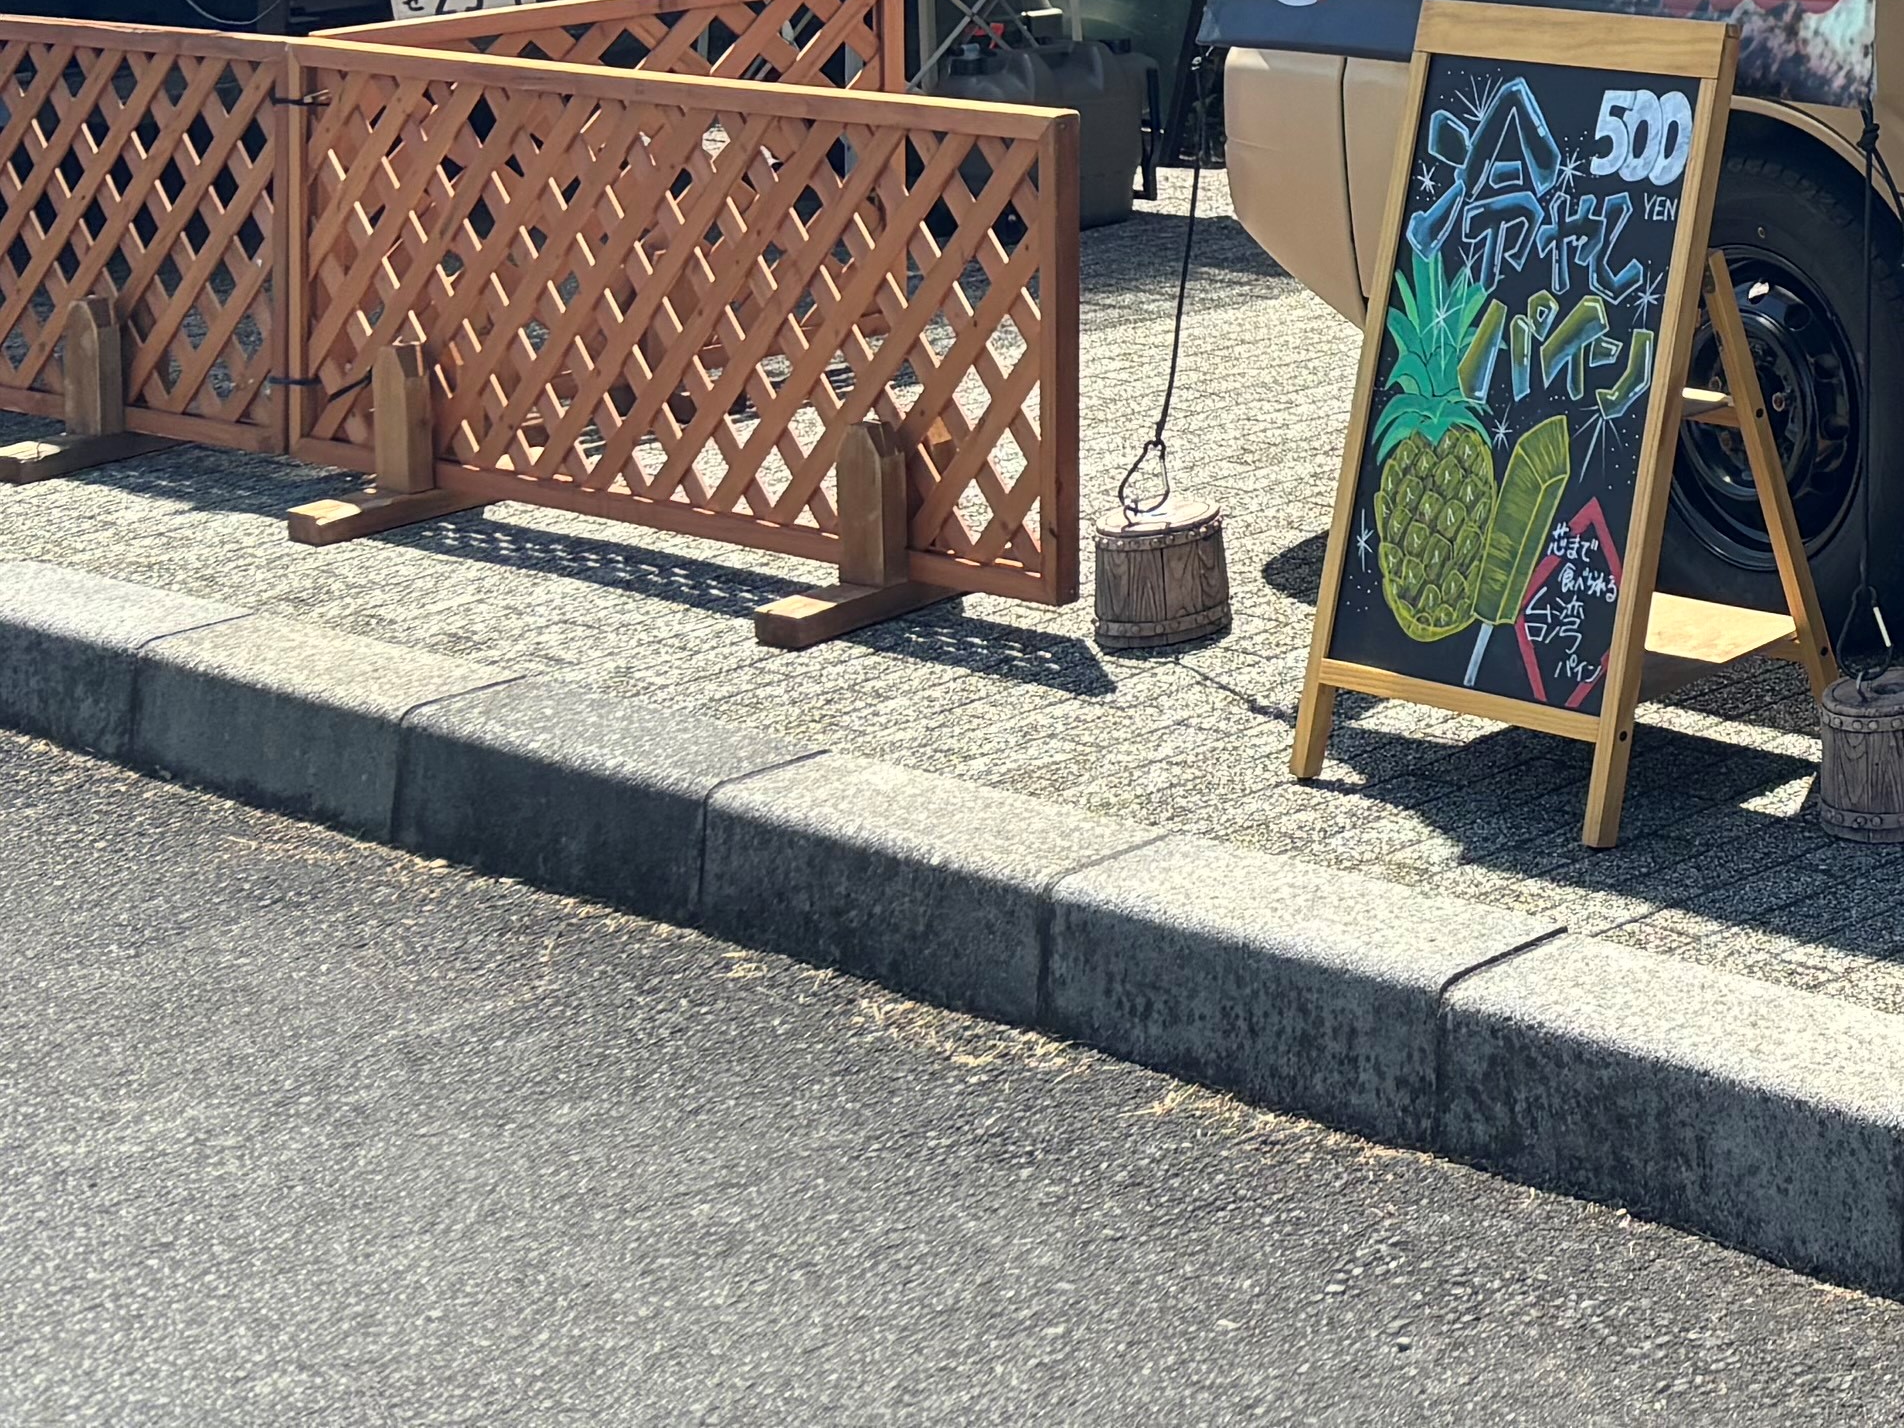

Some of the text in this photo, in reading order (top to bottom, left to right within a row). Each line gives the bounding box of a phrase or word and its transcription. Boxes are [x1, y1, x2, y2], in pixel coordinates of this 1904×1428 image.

[1590, 88, 1693, 187] 500
[1406, 75, 1645, 306] 冷やし
[1641, 192, 1678, 223] YEN
[1457, 290, 1653, 421] パイン
[1547, 521, 1599, 563] 芯まで
[1557, 562, 1618, 603] 食べられる
[1524, 585, 1587, 655] 台湾
[1554, 654, 1602, 683] パイン
